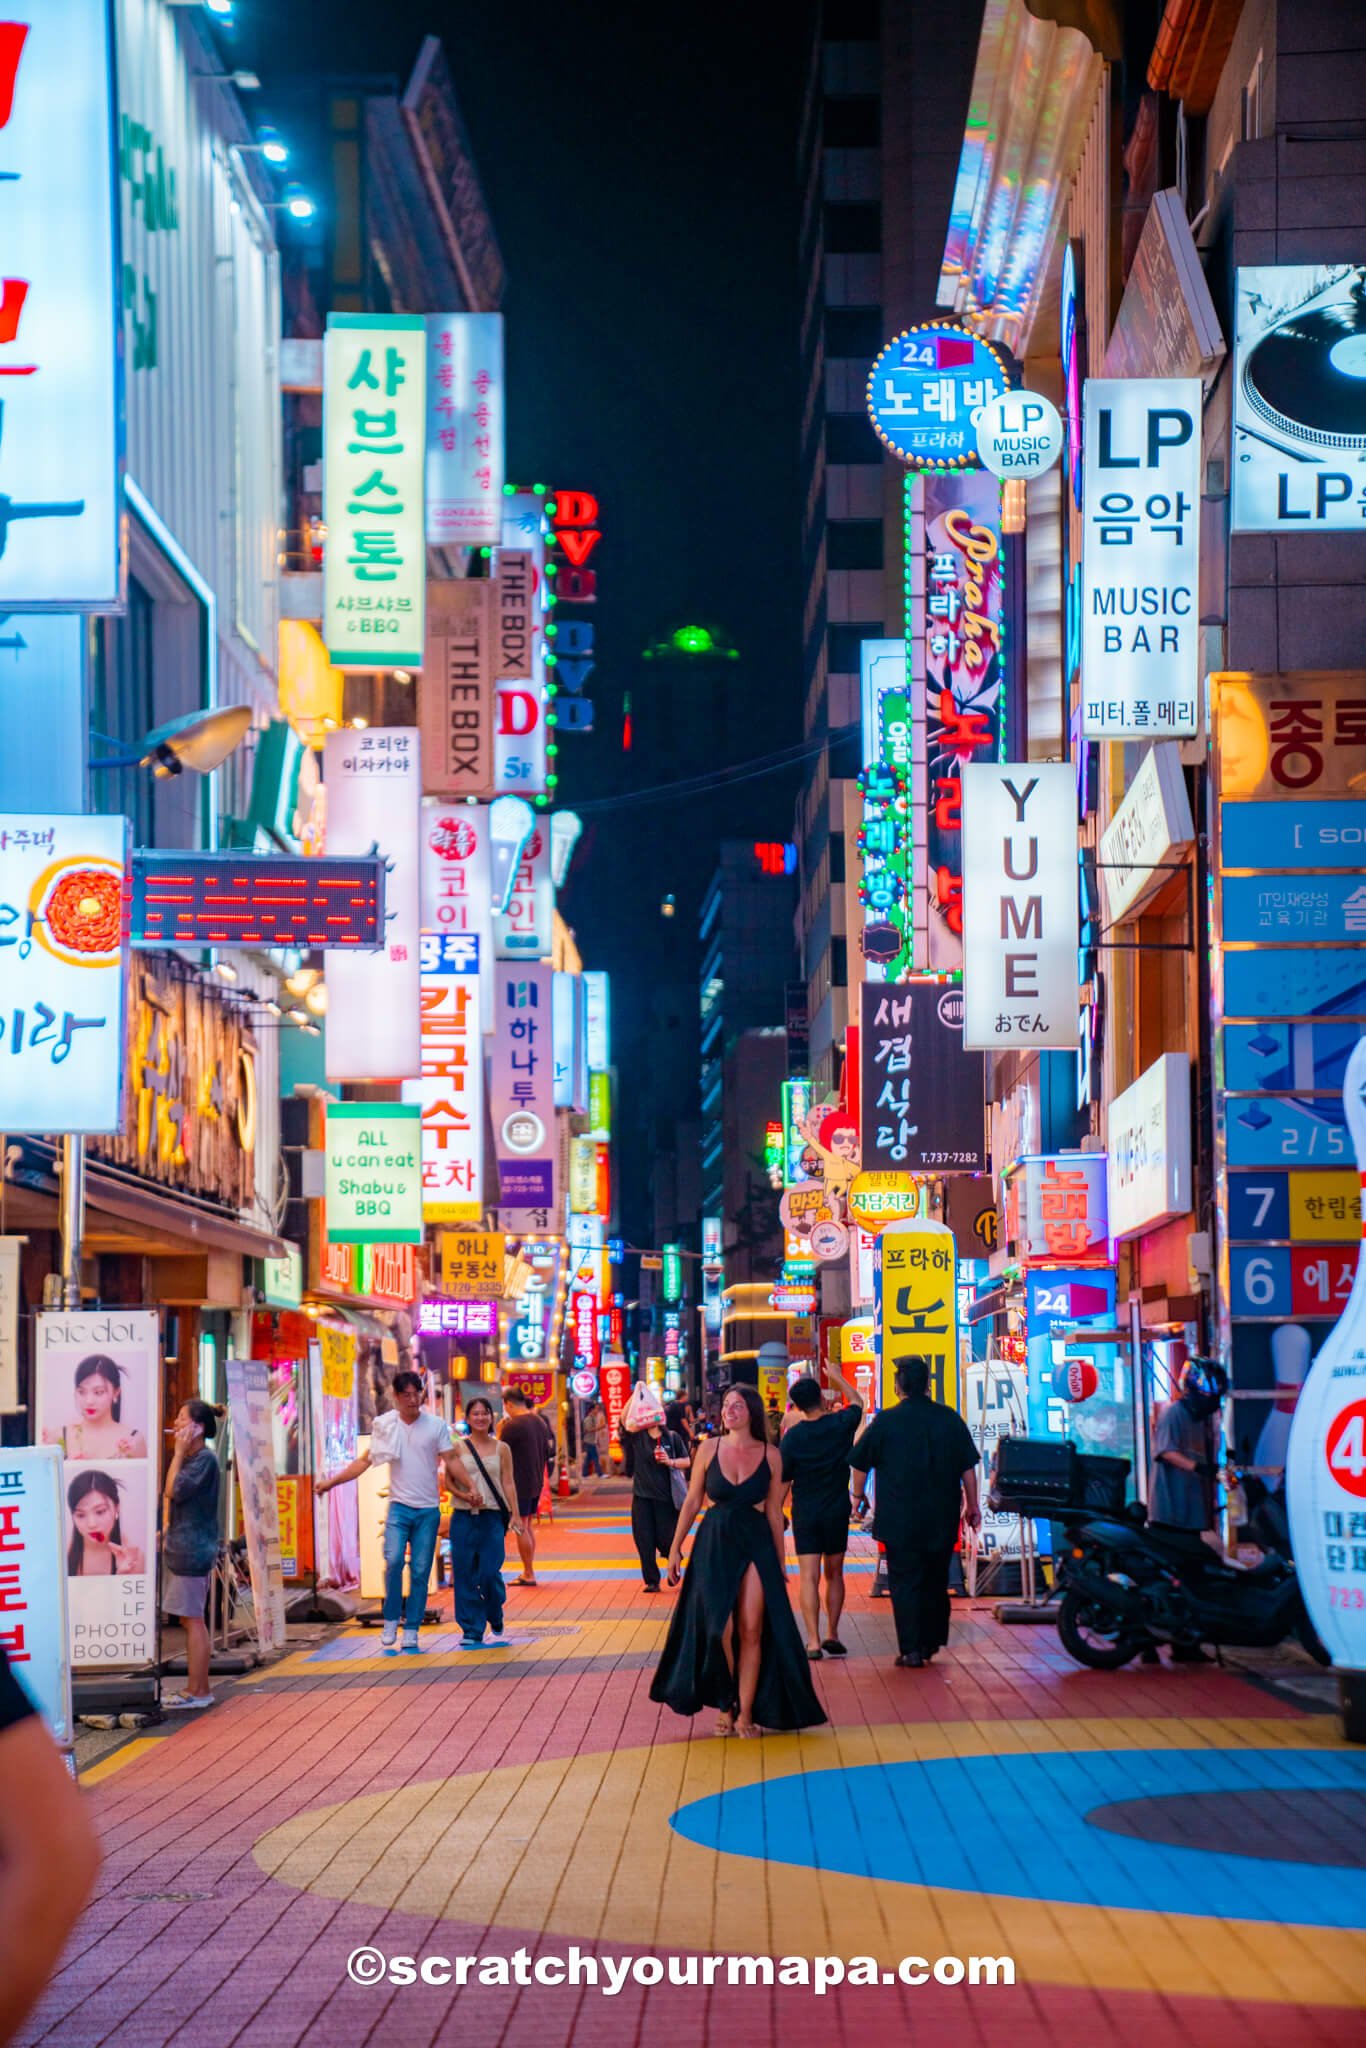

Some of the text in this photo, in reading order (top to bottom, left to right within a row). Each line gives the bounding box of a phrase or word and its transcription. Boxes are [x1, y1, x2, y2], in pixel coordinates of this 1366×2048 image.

[903, 342, 935, 367] 24
[878, 377, 999, 430] 노래방
[999, 404, 1044, 433] LP
[911, 431, 965, 449] 프라하
[993, 436, 1051, 452] MUSIC
[1098, 408, 1194, 469] LP
[346, 346, 406, 582] 샤브스톤
[1001, 452, 1040, 467] BAR
[1277, 472, 1353, 520] LP
[1092, 490, 1192, 546] 음악
[944, 508, 1001, 669] Praha
[1092, 586, 1192, 616] MUSIC
[336, 596, 414, 612] 샤브샤브
[502, 555, 525, 669] THE BOX
[929, 553, 961, 664] 프라하
[1104, 624, 1180, 653] BAR
[451, 638, 480, 702] THE
[1087, 701, 1194, 728] 피터.폴.메리
[359, 736, 410, 753] 코리안
[451, 710, 480, 776] BOX
[342, 756, 411, 773] 이자카야
[999, 777, 1044, 998] YUME
[994, 1012, 1050, 1034] おでん
[420, 984, 472, 1150] 칼국수
[873, 994, 919, 1162] 새겹식당
[357, 1131, 388, 1147] ALL
[332, 1152, 415, 1168] u can eat
[920, 1152, 979, 1163] T.737-7282
[338, 1178, 394, 1195] Shabu
[355, 1200, 392, 1217] BBQ
[851, 1191, 916, 1212] 자담치킨
[1040, 1160, 1092, 1257] 노래방
[1245, 1187, 1275, 1228] 7
[456, 1238, 489, 1257] 하나
[886, 1247, 952, 1272] 프라하
[449, 1260, 498, 1280] 부동산
[1243, 1258, 1275, 1305] 6
[1036, 1288, 1070, 1315] 24
[419, 1302, 491, 1332] 멀티룸
[44, 1319, 87, 1349] pic
[976, 1379, 1013, 1411] LP
[122, 1579, 146, 1595] SE
[122, 1601, 146, 1618] LF
[74, 1622, 147, 1640] PHOTO
[73, 1642, 147, 1660] BOOTH
